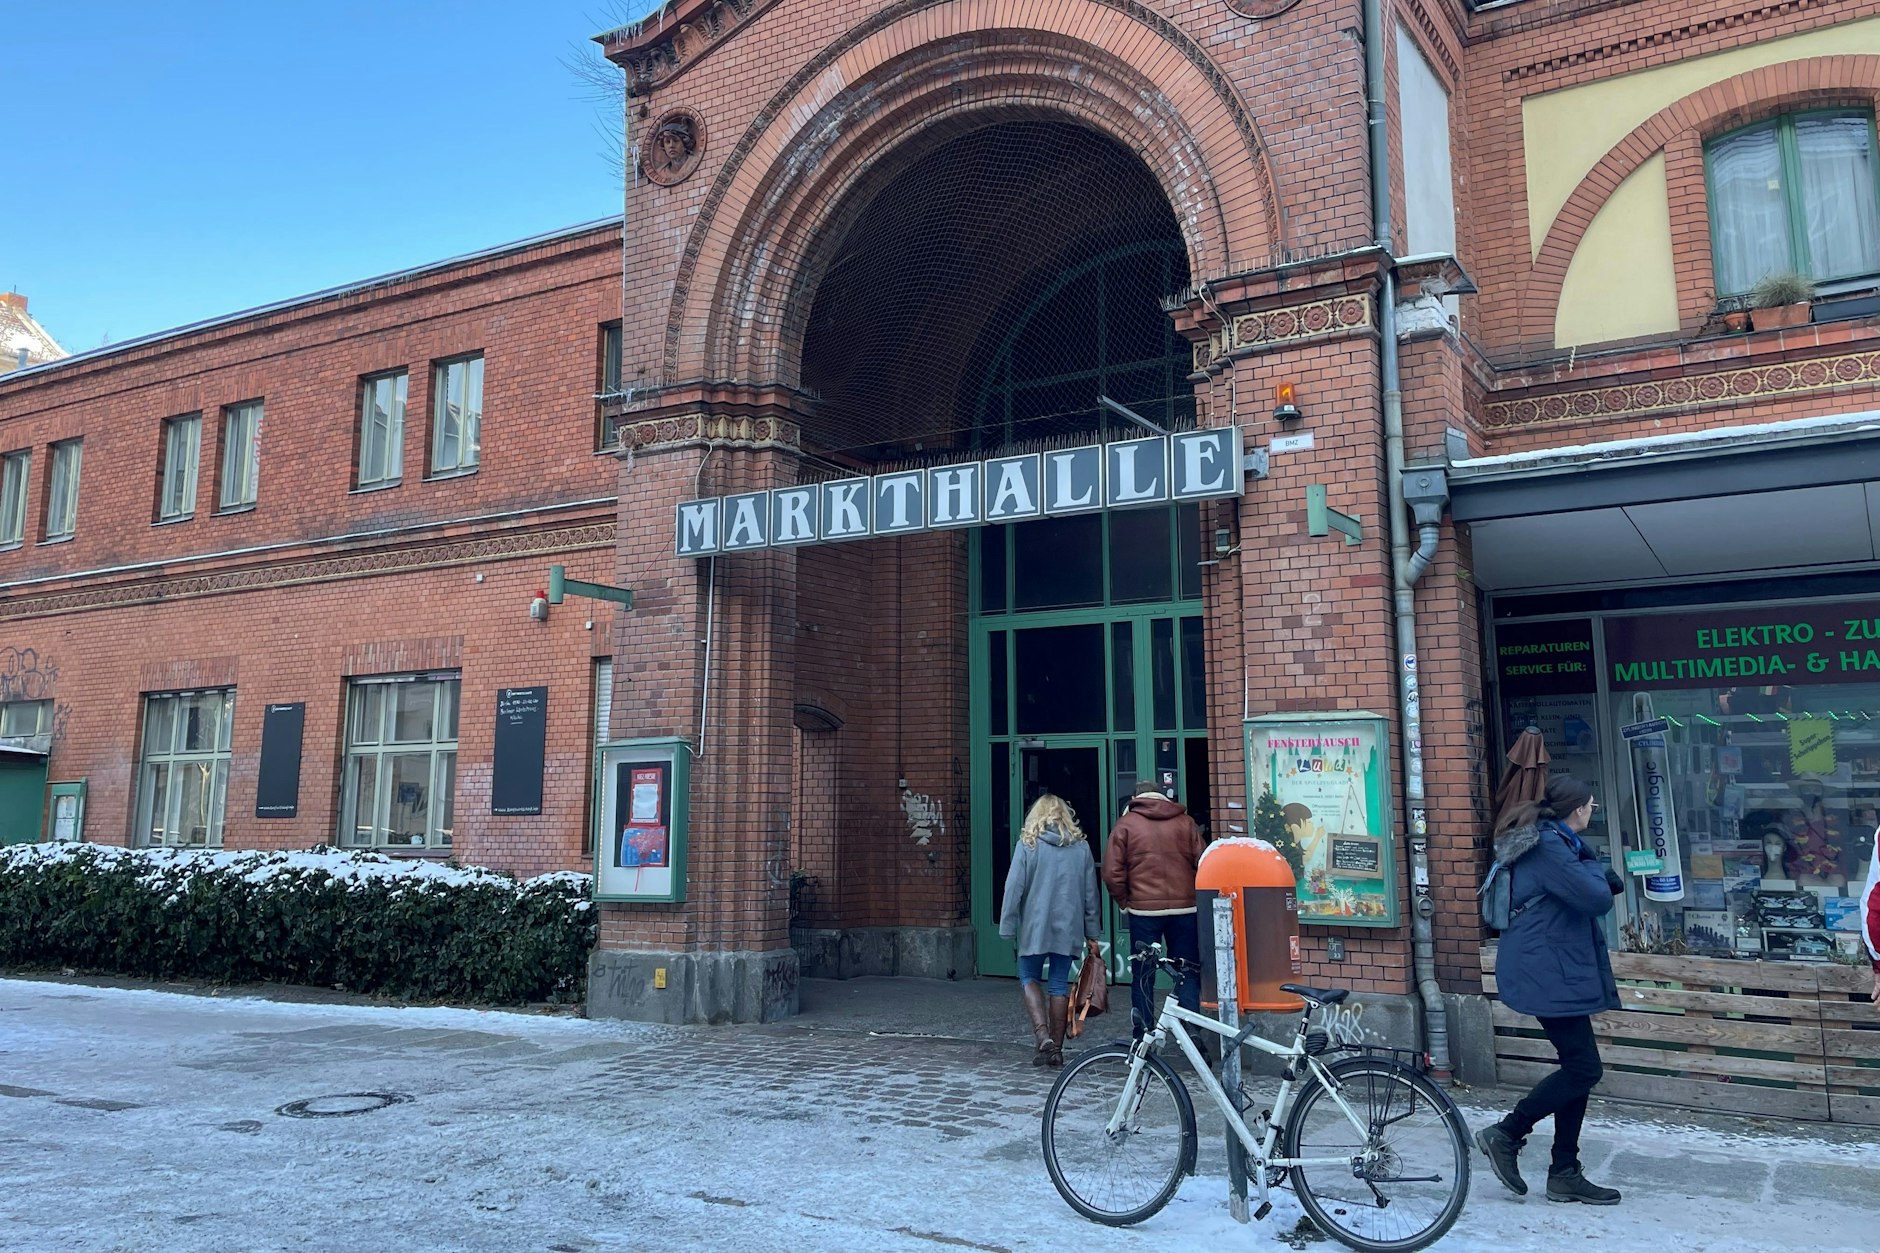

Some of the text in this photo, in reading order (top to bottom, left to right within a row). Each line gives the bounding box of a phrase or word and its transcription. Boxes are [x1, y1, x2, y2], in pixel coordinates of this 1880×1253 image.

[1285, 439, 1299, 447] BMZ
[678, 435, 1226, 553] MARKTHALLE
[1696, 622, 1814, 649] ELEKTRO
[1844, 618, 1880, 641] ZU
[1499, 641, 1590, 656] REPARATUREN
[1505, 661, 1587, 675] SERVICE FÜR:
[1614, 649, 1880, 682] MULTIMEDIA- & HA
[1267, 737, 1360, 749] FENSTERTAUSCH
